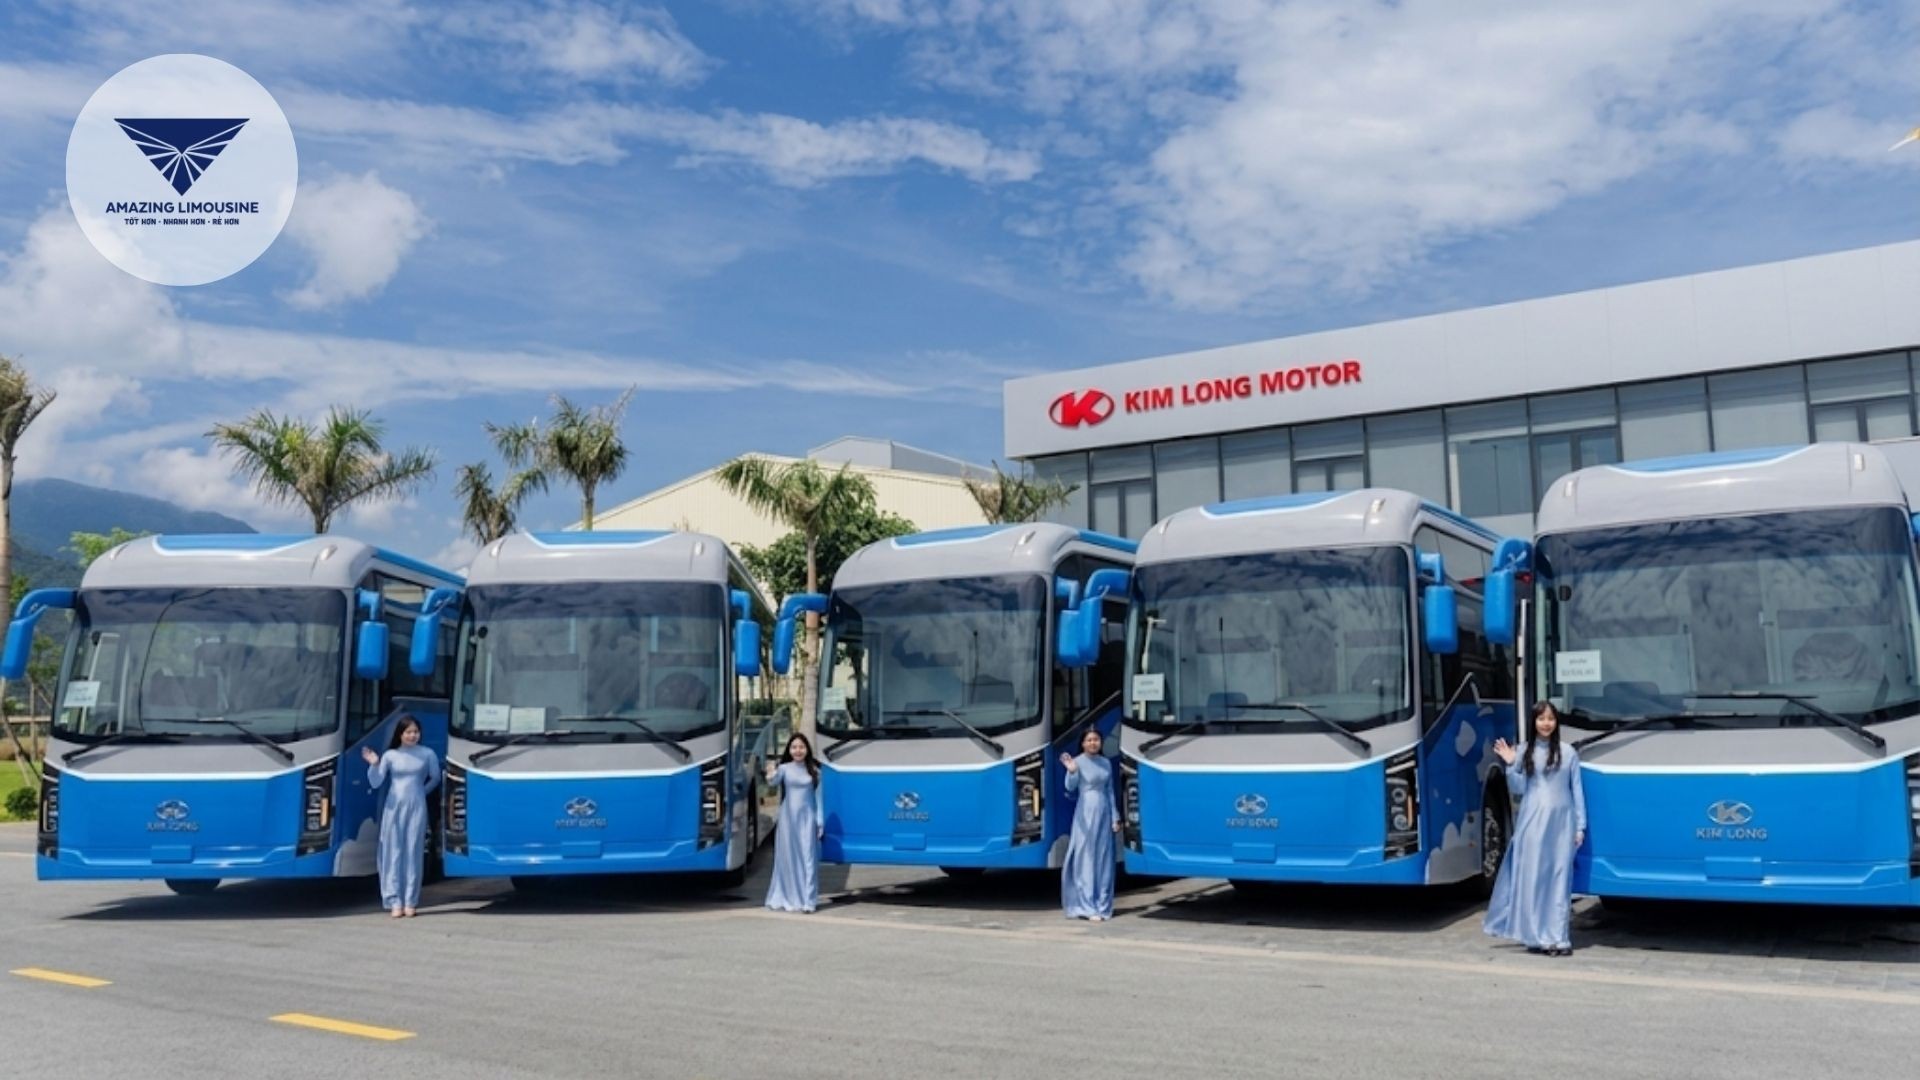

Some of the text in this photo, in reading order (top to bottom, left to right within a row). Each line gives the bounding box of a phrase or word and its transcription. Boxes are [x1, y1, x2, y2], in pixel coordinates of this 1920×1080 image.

[1125, 360, 1362, 414] KIM LONG MOTOR
[1696, 827, 1767, 840] KIM LONG
